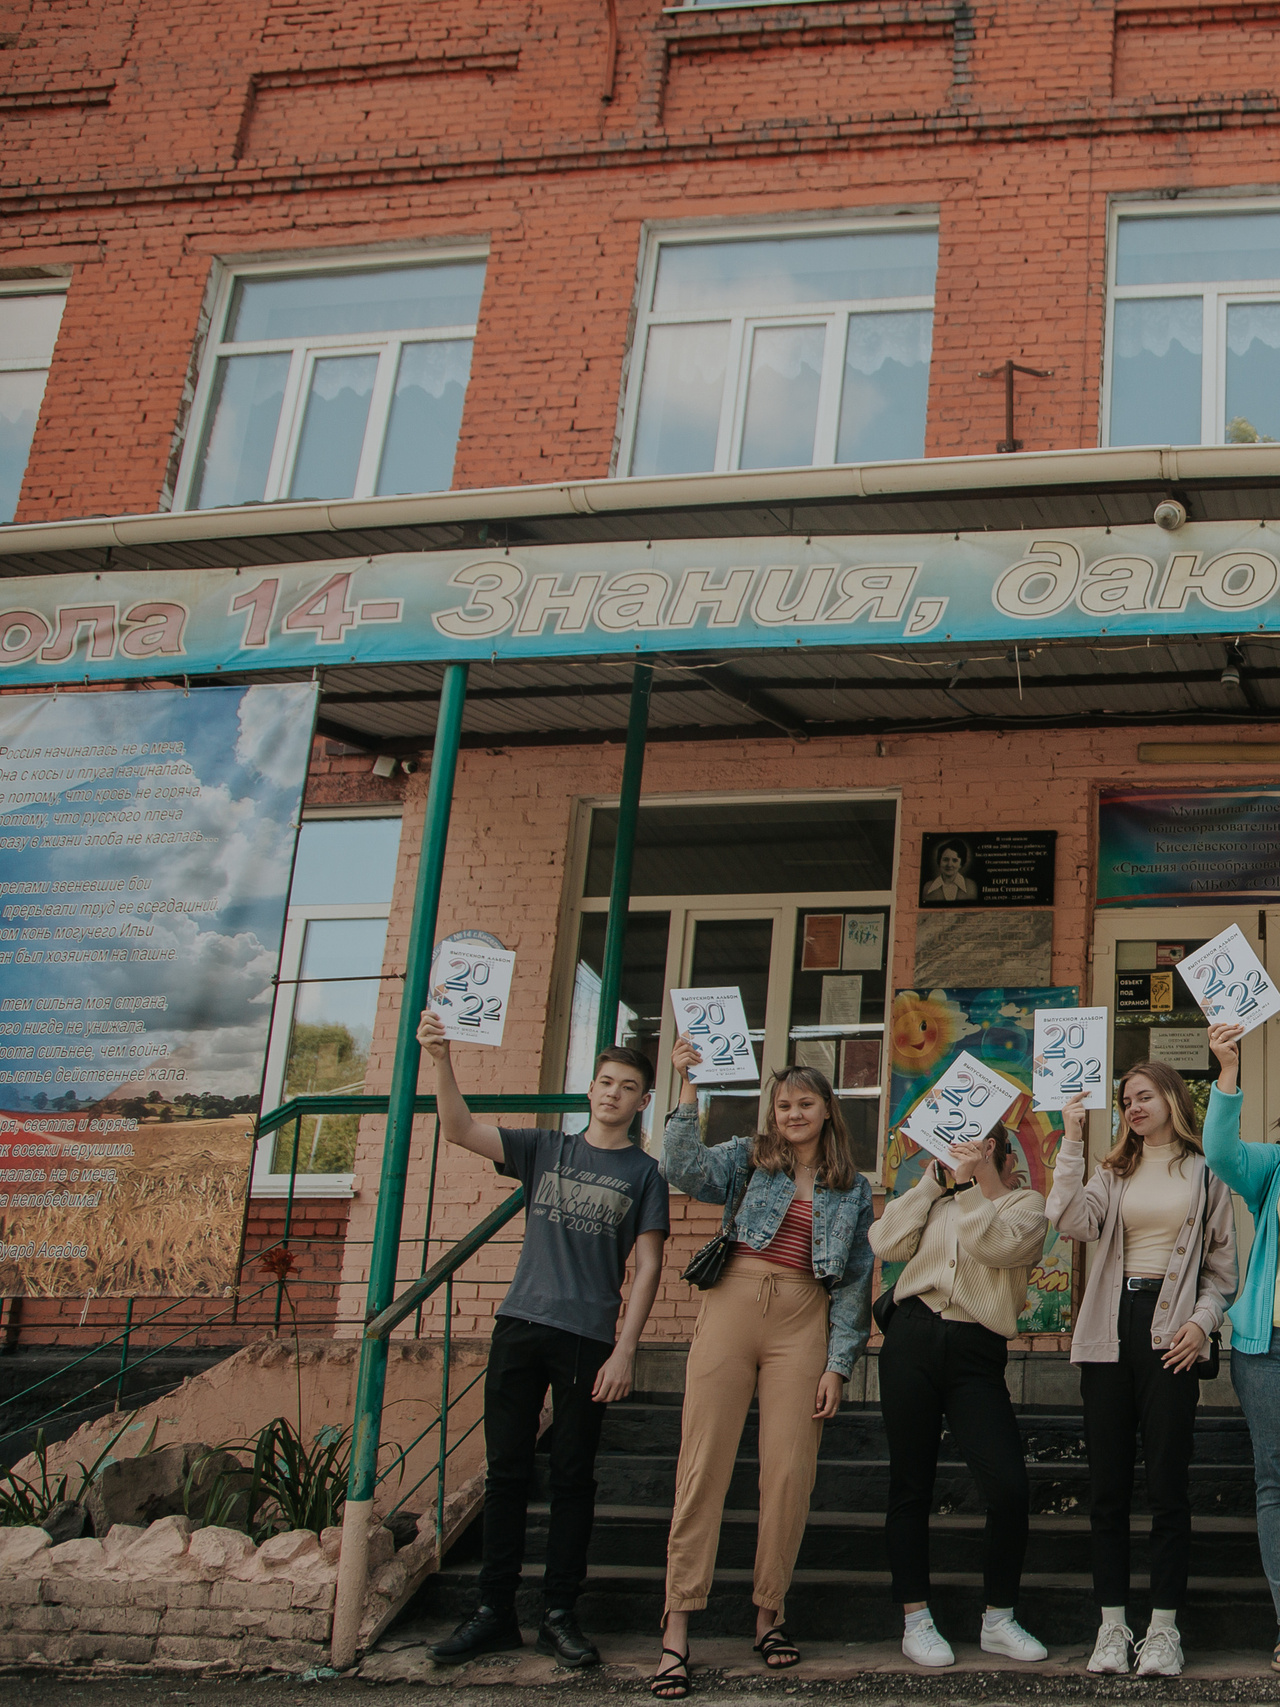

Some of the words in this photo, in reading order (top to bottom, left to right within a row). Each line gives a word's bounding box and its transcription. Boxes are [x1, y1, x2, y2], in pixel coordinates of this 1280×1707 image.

[228, 572, 403, 650] 14-
[432, 558, 949, 640] Знания,
[43, 744, 117, 758] начиналась
[122, 743, 138, 756] не
[141, 743, 149, 755] с
[150, 740, 187, 757] меча,
[21, 769, 29, 781] с
[31, 768, 63, 780] косы
[66, 768, 73, 780] и
[77, 766, 114, 782] плуга
[8, 790, 61, 806] потому,
[65, 789, 93, 803] что
[95, 787, 132, 804] кровь
[135, 786, 152, 799] не
[53, 812, 80, 825] что
[81, 810, 141, 827] русского
[143, 808, 184, 822] плеча
[1170, 802, 1280, 818] Муниципальное
[30, 835, 39, 848] в
[40, 834, 82, 848] жизни
[84, 831, 123, 847] злоба
[126, 832, 142, 845] не
[1155, 838, 1248, 854] Киселёвского
[1112, 861, 1176, 876] «Средняя
[0, 880, 51, 897] релами
[52, 878, 125, 893] звеневшие
[128, 874, 153, 890] бои
[1189, 877, 1240, 893] (МБОУ
[2, 903, 78, 921] прерывали
[79, 898, 116, 920] труд
[118, 902, 134, 915] ее
[137, 897, 220, 915] всегдашний.
[20, 926, 52, 941] конь
[54, 925, 117, 944] могучего
[118, 922, 155, 939] Ильи
[14, 947, 44, 964] был
[45, 948, 109, 964] хозяином
[111, 948, 128, 962] на
[130, 947, 179, 962] пашне.
[445, 957, 490, 991] 20
[1193, 952, 1234, 999] 20
[1119, 998, 1149, 1006] ОХРАНОЙ
[1225, 969, 1269, 1017] 22
[0, 997, 33, 1011] тем
[35, 997, 83, 1011] сильна
[84, 996, 113, 1010] моя
[114, 995, 169, 1013] страна,
[457, 993, 502, 1027] 22
[683, 1002, 725, 1034] 20
[22, 1017, 65, 1035] нигде
[65, 1021, 83, 1034] не
[84, 1020, 147, 1038] унижала.
[707, 1032, 749, 1066] 22
[1043, 1023, 1085, 1058] 20
[37, 1044, 95, 1061] сильнее,
[99, 1043, 126, 1057] чем
[54, 1066, 146, 1083] действеннее
[147, 1067, 188, 1082] жала.
[1060, 1057, 1101, 1093] 22
[941, 1071, 991, 1108] 20
[23, 1117, 75, 1132] светла
[78, 1118, 87, 1131] и
[88, 1117, 140, 1134] горяча.
[11, 1144, 60, 1158] вовеки
[62, 1142, 136, 1161] нерушимо.
[48, 1168, 68, 1182] не
[70, 1168, 79, 1182] с
[80, 1167, 119, 1184] меча,
[596, 1175, 632, 1192] BRAVE
[10, 1190, 102, 1208] непобедима!
[36, 1241, 89, 1259] Асадов
